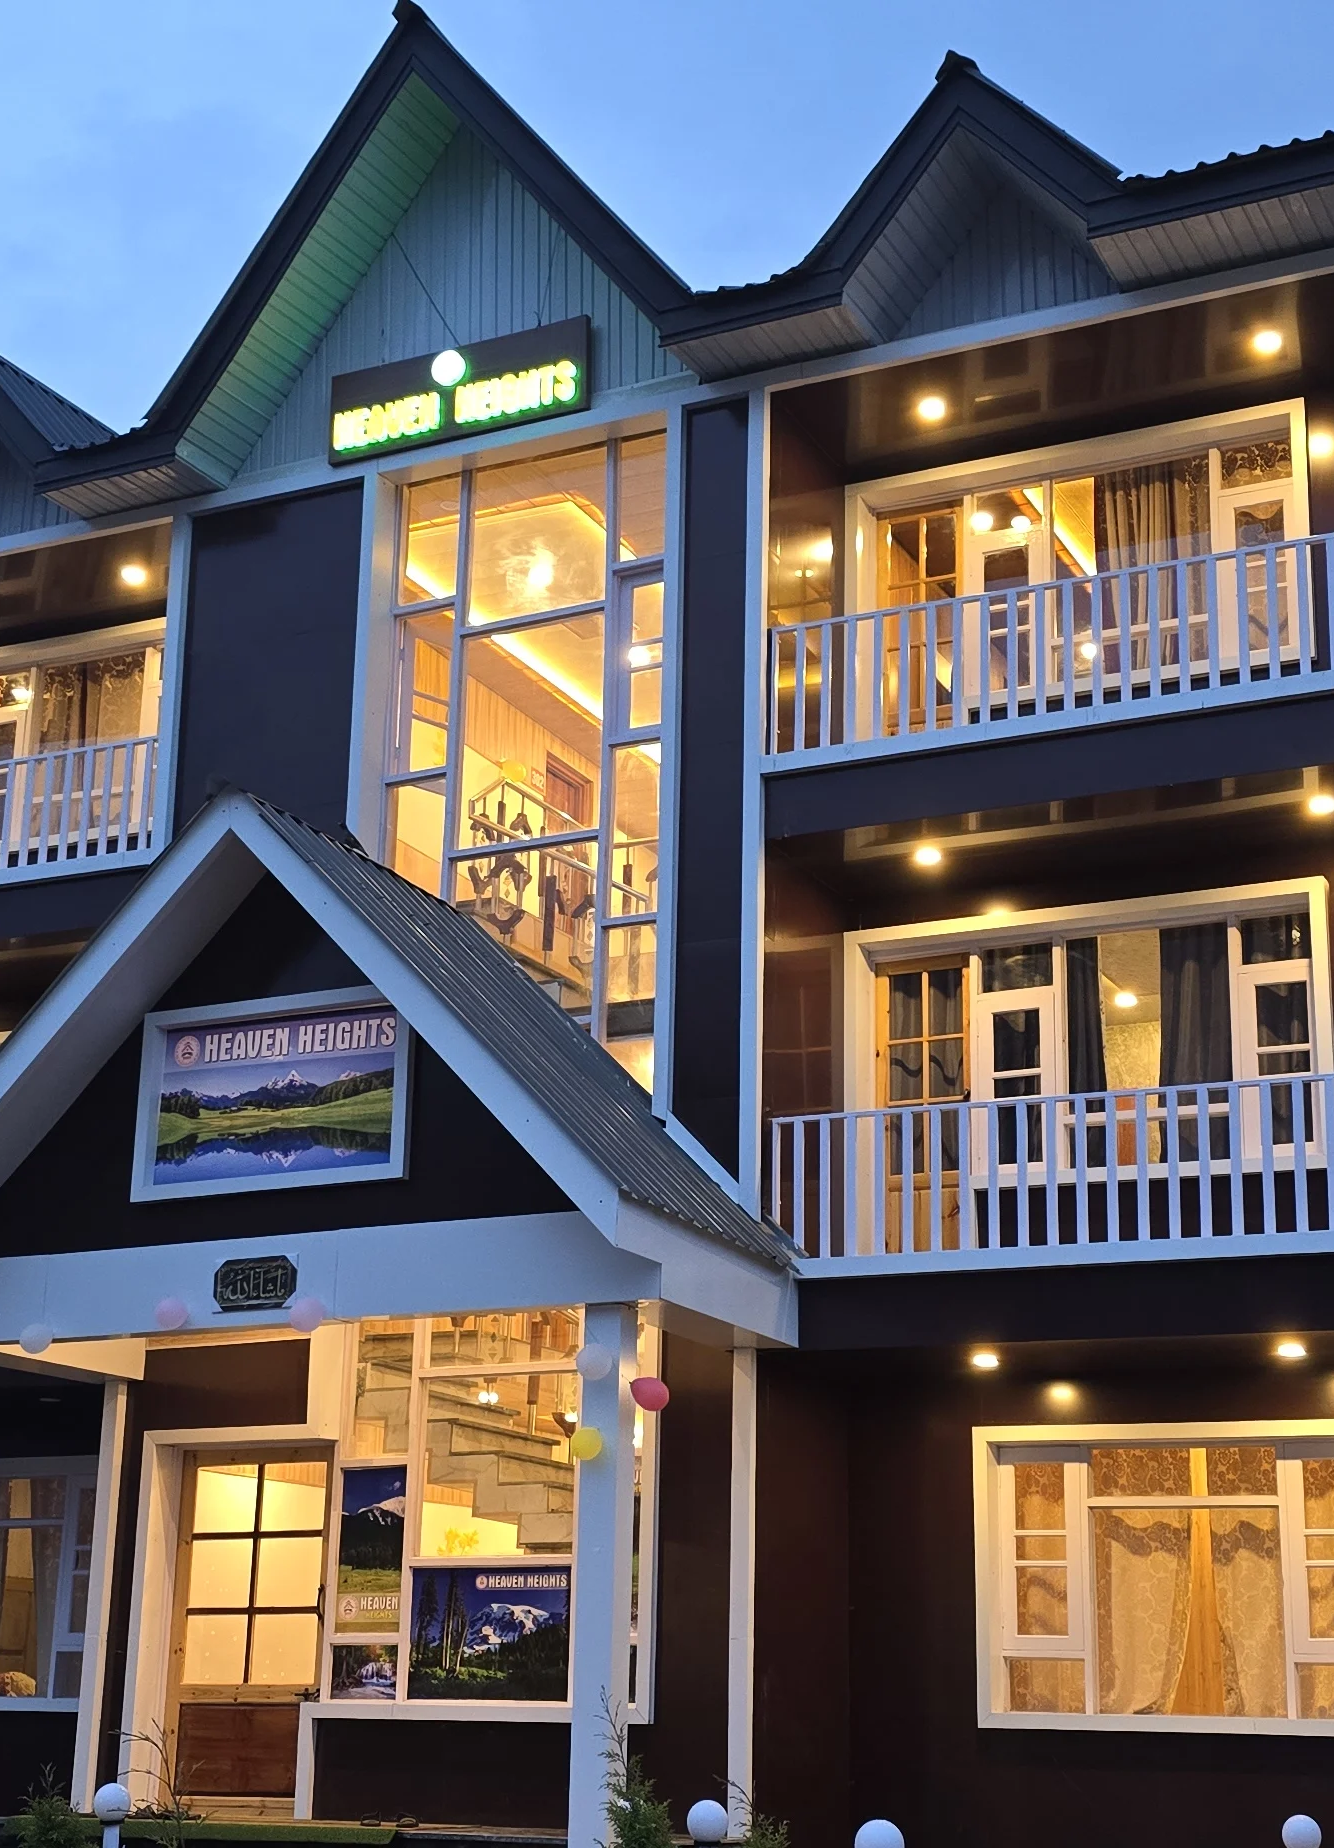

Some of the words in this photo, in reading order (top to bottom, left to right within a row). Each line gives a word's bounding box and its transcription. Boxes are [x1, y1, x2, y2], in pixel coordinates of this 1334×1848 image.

[333, 392, 441, 450] HEAVEN
[454, 360, 577, 424] HEIGHTS
[205, 1027, 289, 1063] HEAVEN
[298, 1017, 397, 1054] HEIGHTS
[488, 1575, 524, 1588] HEAVEN
[527, 1574, 567, 1587] HEIGHTS
[360, 1596, 398, 1610] HEAVEN
